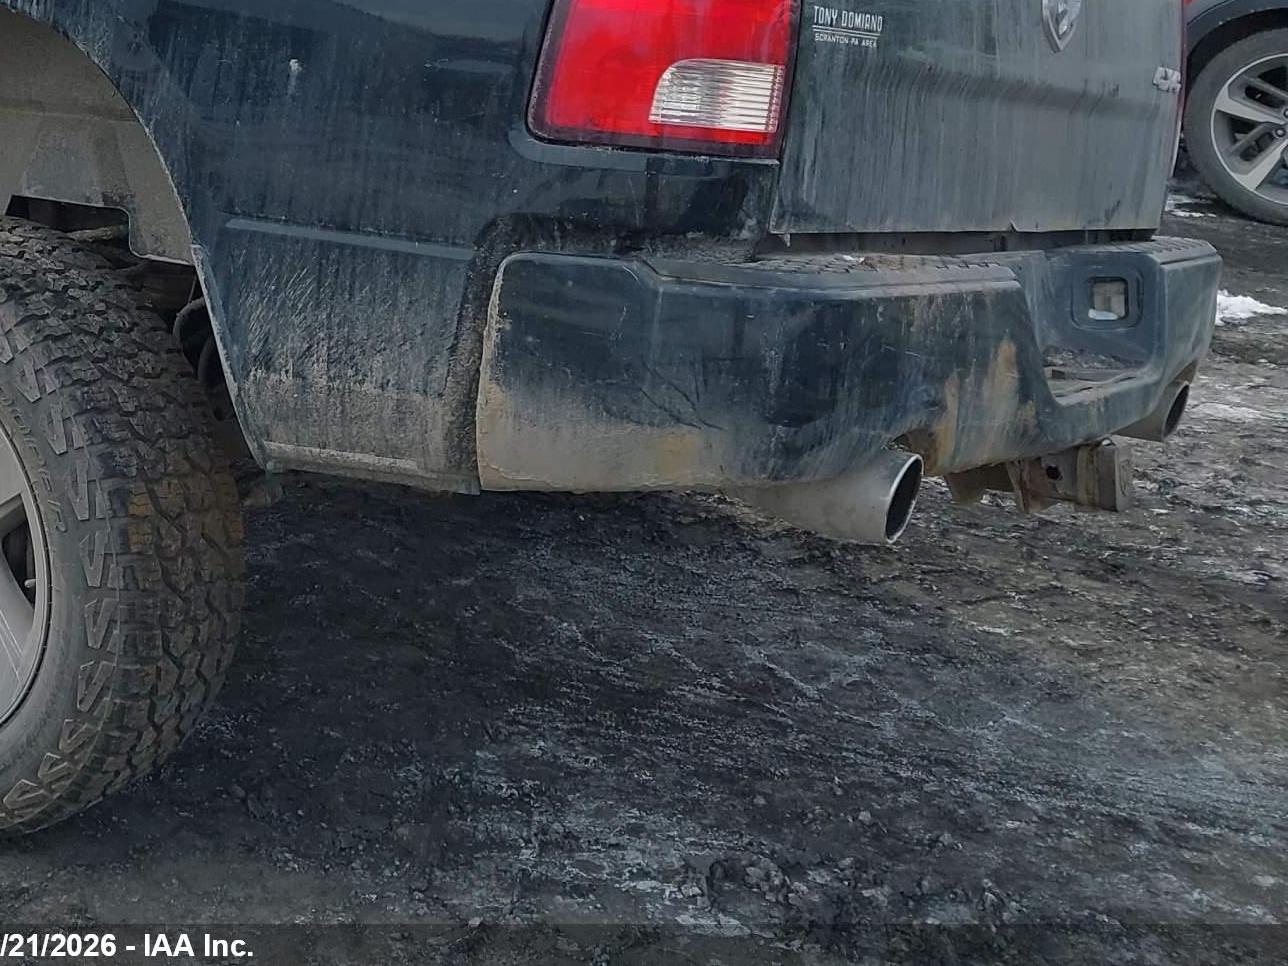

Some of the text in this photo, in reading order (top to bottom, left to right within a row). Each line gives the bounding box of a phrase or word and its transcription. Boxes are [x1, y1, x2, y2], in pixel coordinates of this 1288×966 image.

[814, 5, 884, 32] TONY DOMIANO
[814, 32, 878, 49] SCRANTON PA AREA
